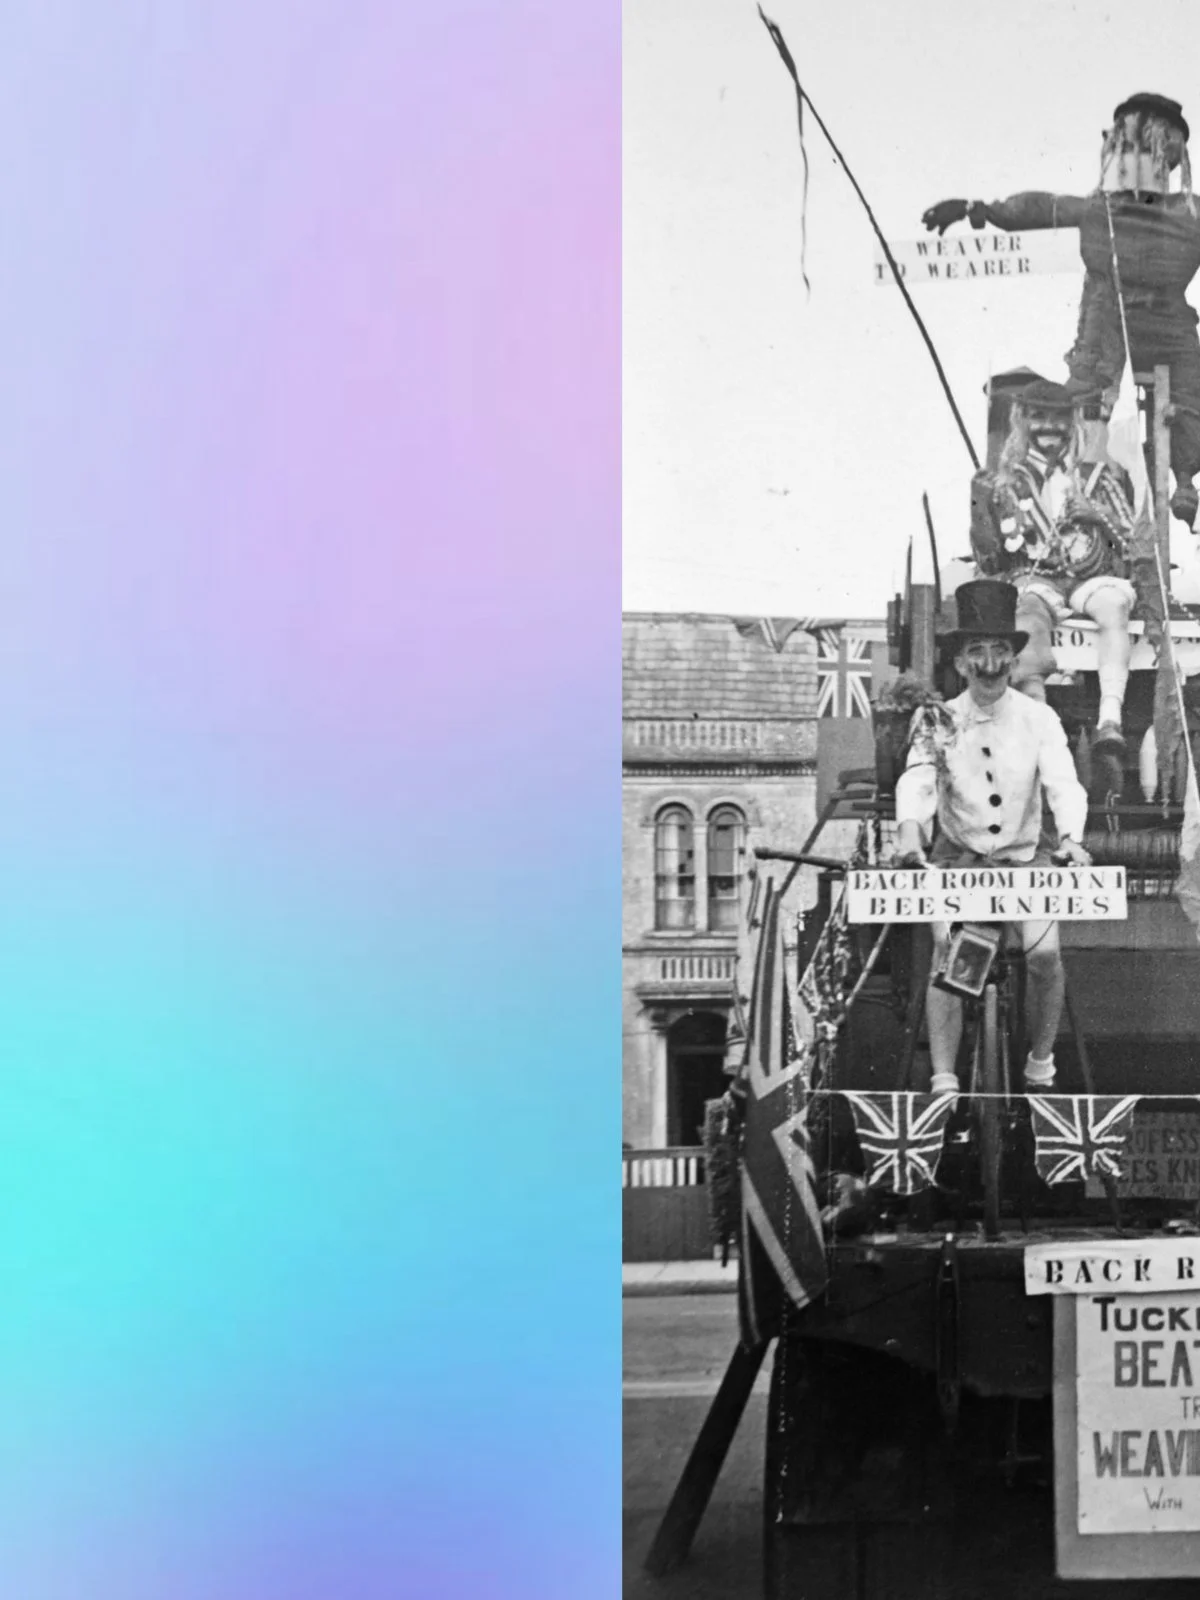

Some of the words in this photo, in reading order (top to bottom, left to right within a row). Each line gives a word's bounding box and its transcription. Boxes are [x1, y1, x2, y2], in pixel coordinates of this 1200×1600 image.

[916, 235, 1022, 256] WEAVER
[927, 257, 1031, 279] WEARER
[853, 871, 929, 891] BACK
[940, 870, 1018, 891] ROOM
[869, 896, 962, 916] BEES
[989, 895, 1110, 915] KNEES
[1045, 1258, 1151, 1284] BACK
